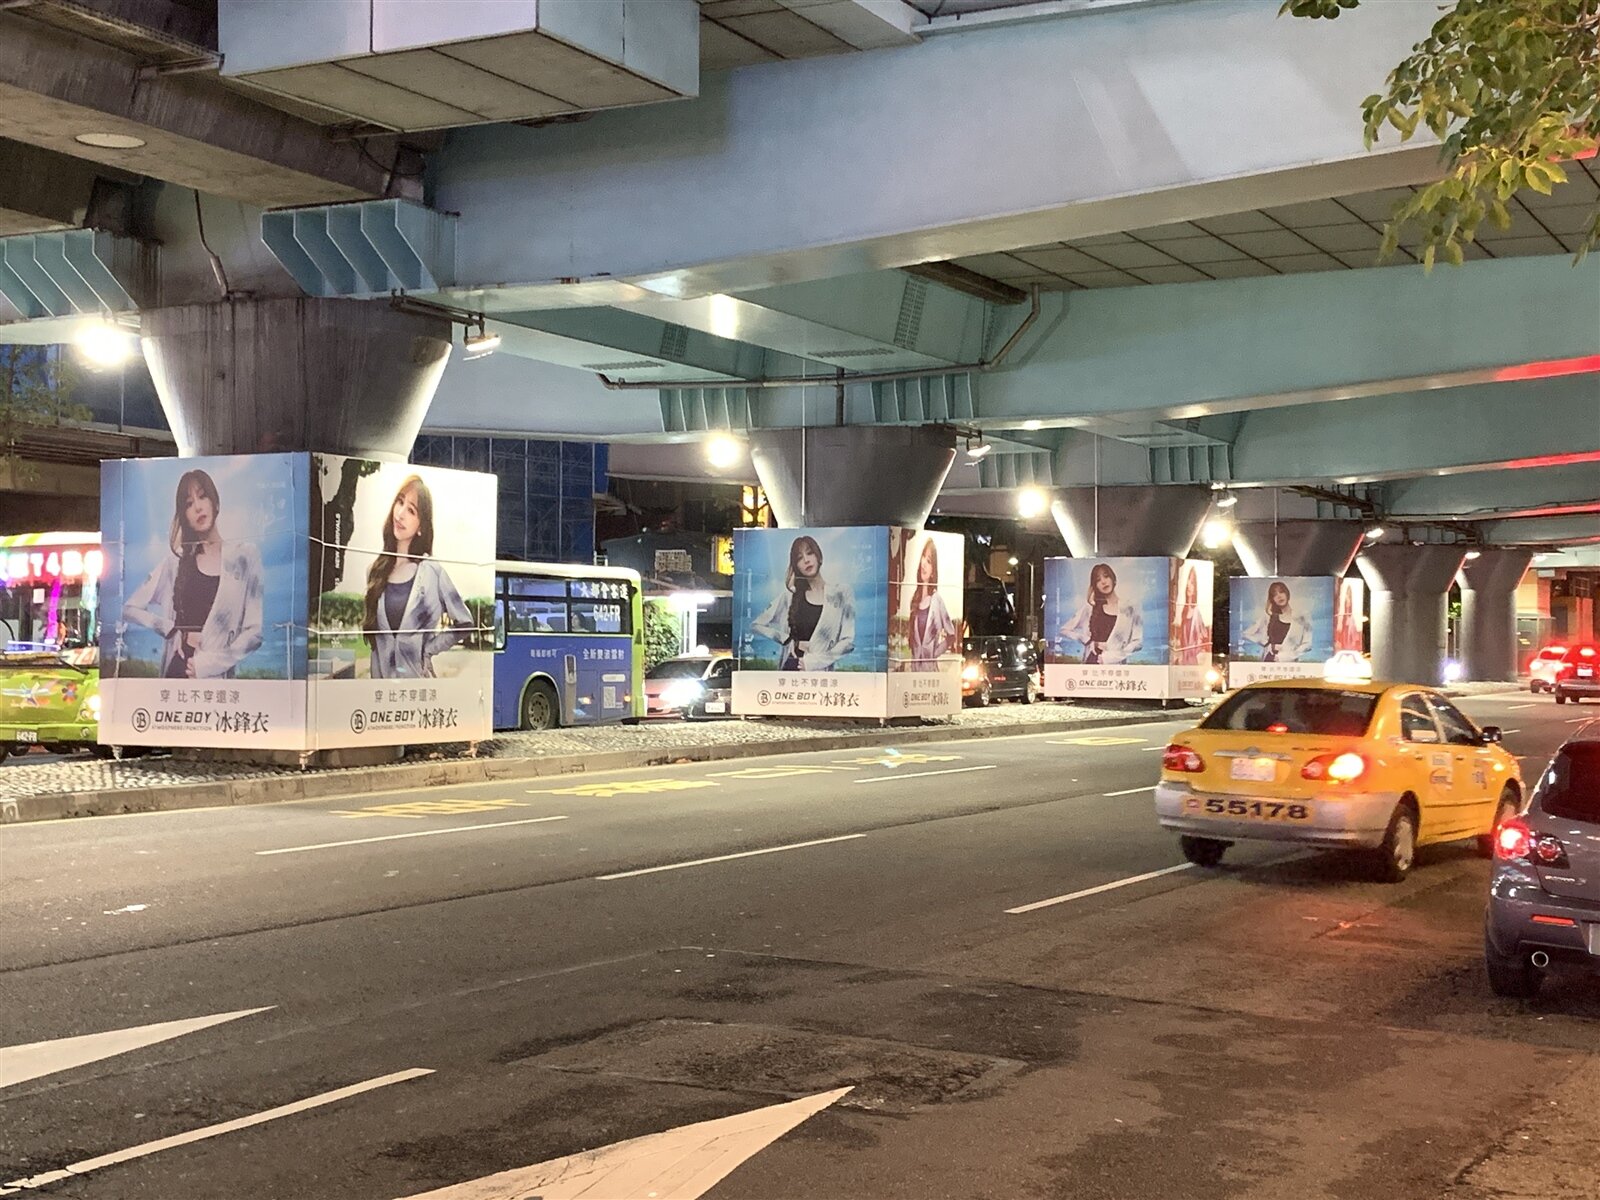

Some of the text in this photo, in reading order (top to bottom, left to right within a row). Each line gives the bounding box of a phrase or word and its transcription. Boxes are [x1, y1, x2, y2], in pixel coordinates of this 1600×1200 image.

[774, 691, 795, 700] ONE
[796, 692, 817, 701] BOY
[819, 691, 860, 707] 冰鋒衣
[154, 711, 183, 723] ONE
[184, 711, 212, 724] BOY
[214, 710, 269, 733] 冰鋒衣
[370, 711, 393, 723] ONE
[394, 710, 416, 722] BOY
[417, 707, 458, 729] 冰鋒衣
[1205, 799, 1308, 819] 55178
